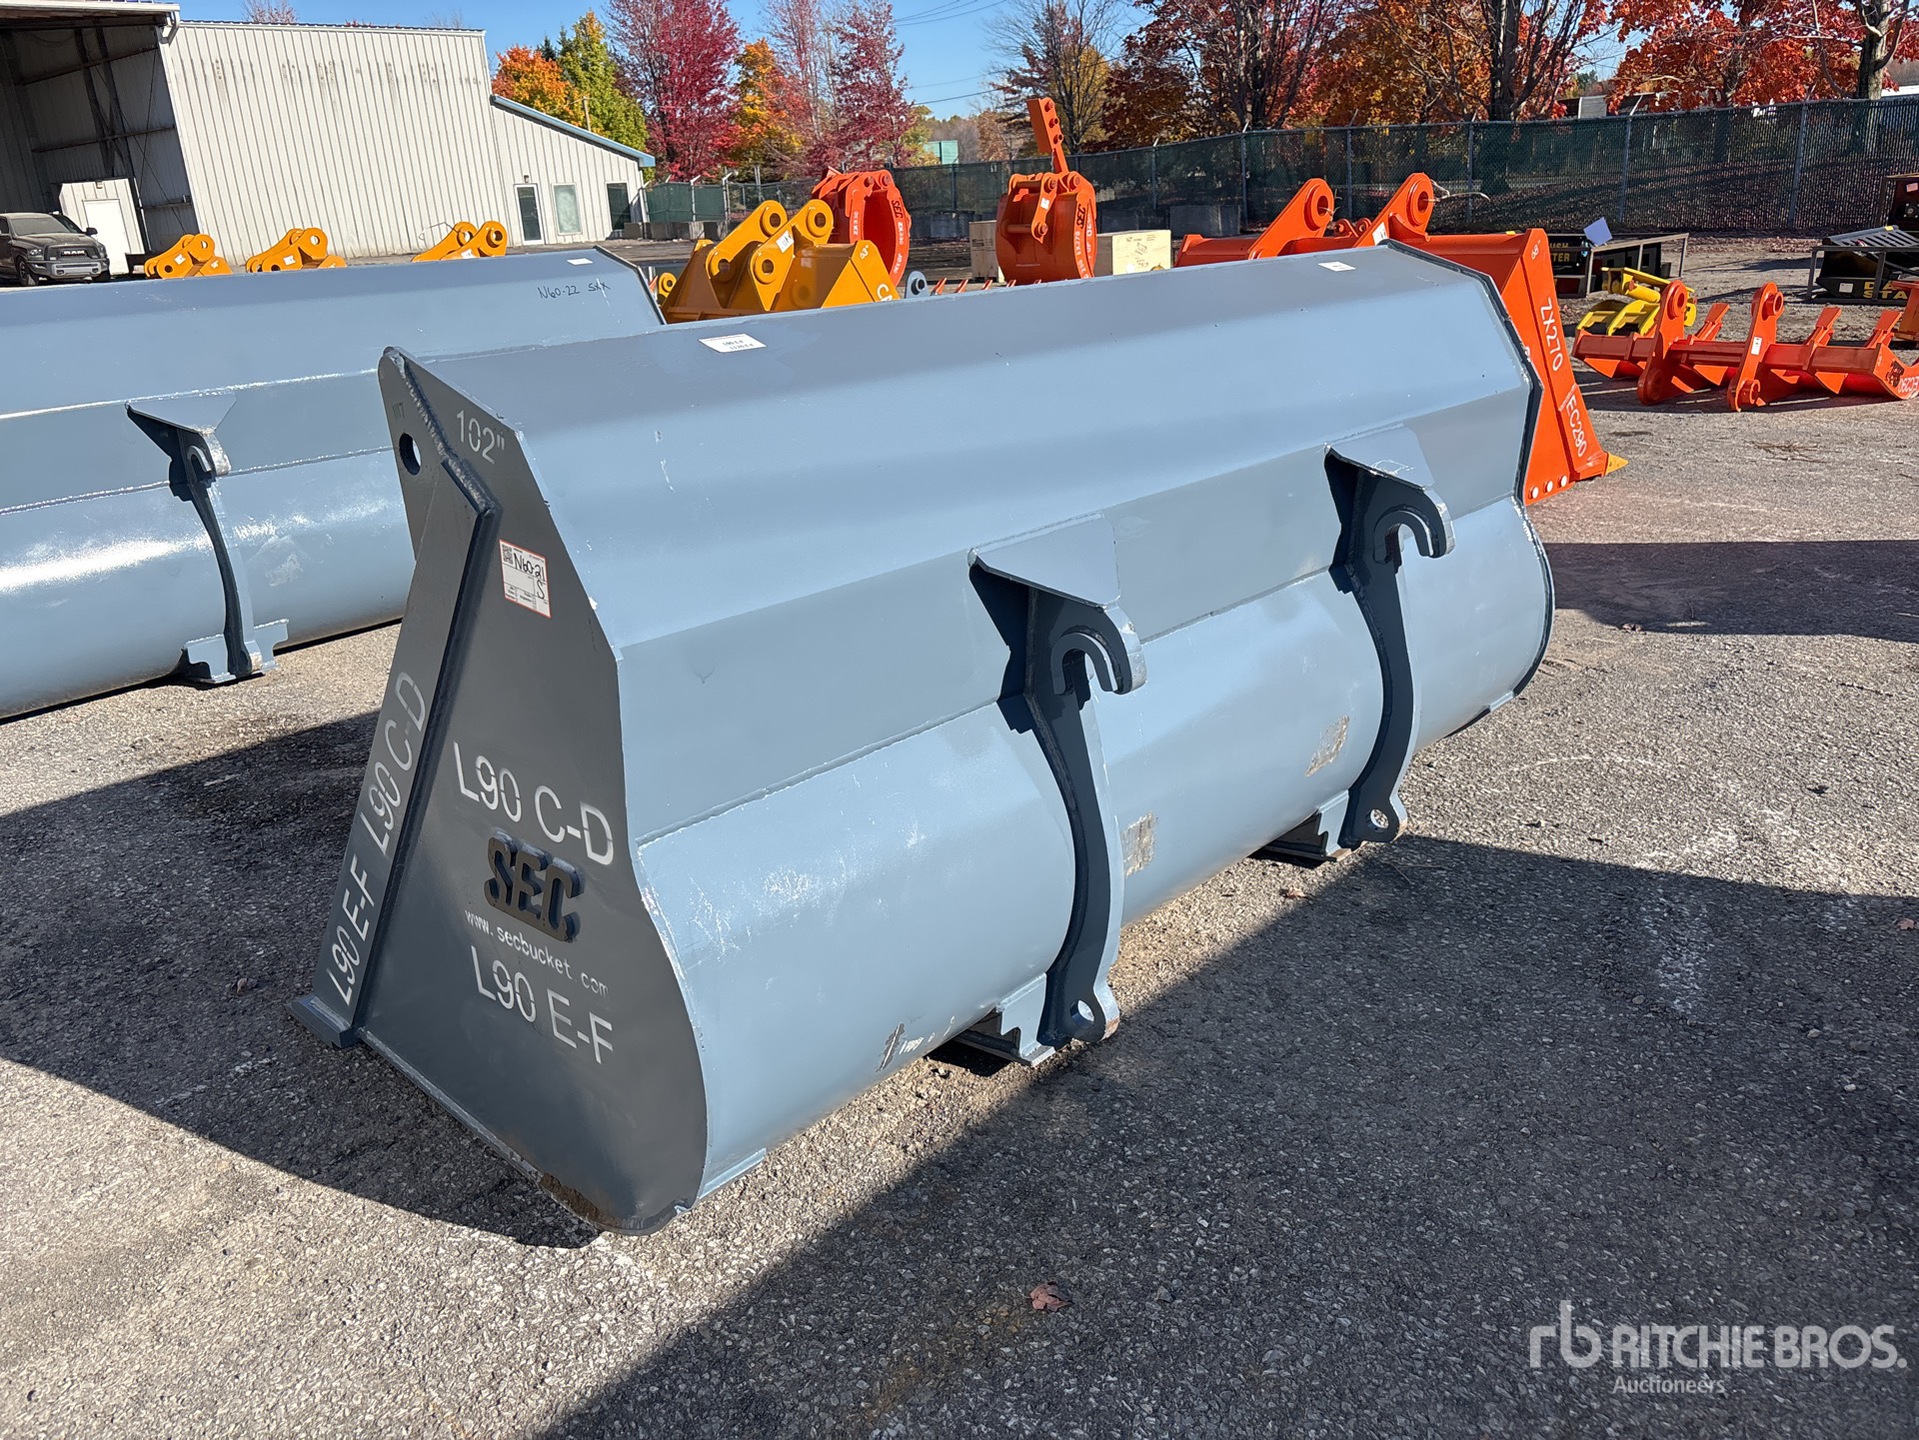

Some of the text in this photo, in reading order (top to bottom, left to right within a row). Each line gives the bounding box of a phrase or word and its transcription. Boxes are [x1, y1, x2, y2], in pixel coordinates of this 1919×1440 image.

[891, 200, 904, 218] SEC
[1076, 204, 1086, 229] SEC
[1540, 297, 1564, 372] ZX270
[457, 410, 505, 465] 102"
[1565, 394, 1587, 458] EC290
[360, 671, 426, 856] L90 C-D
[453, 740, 614, 866] L90 C-D
[326, 853, 375, 1006] L90 E-F
[483, 833, 582, 942] SEC
[471, 945, 614, 1065] L90 E-F
